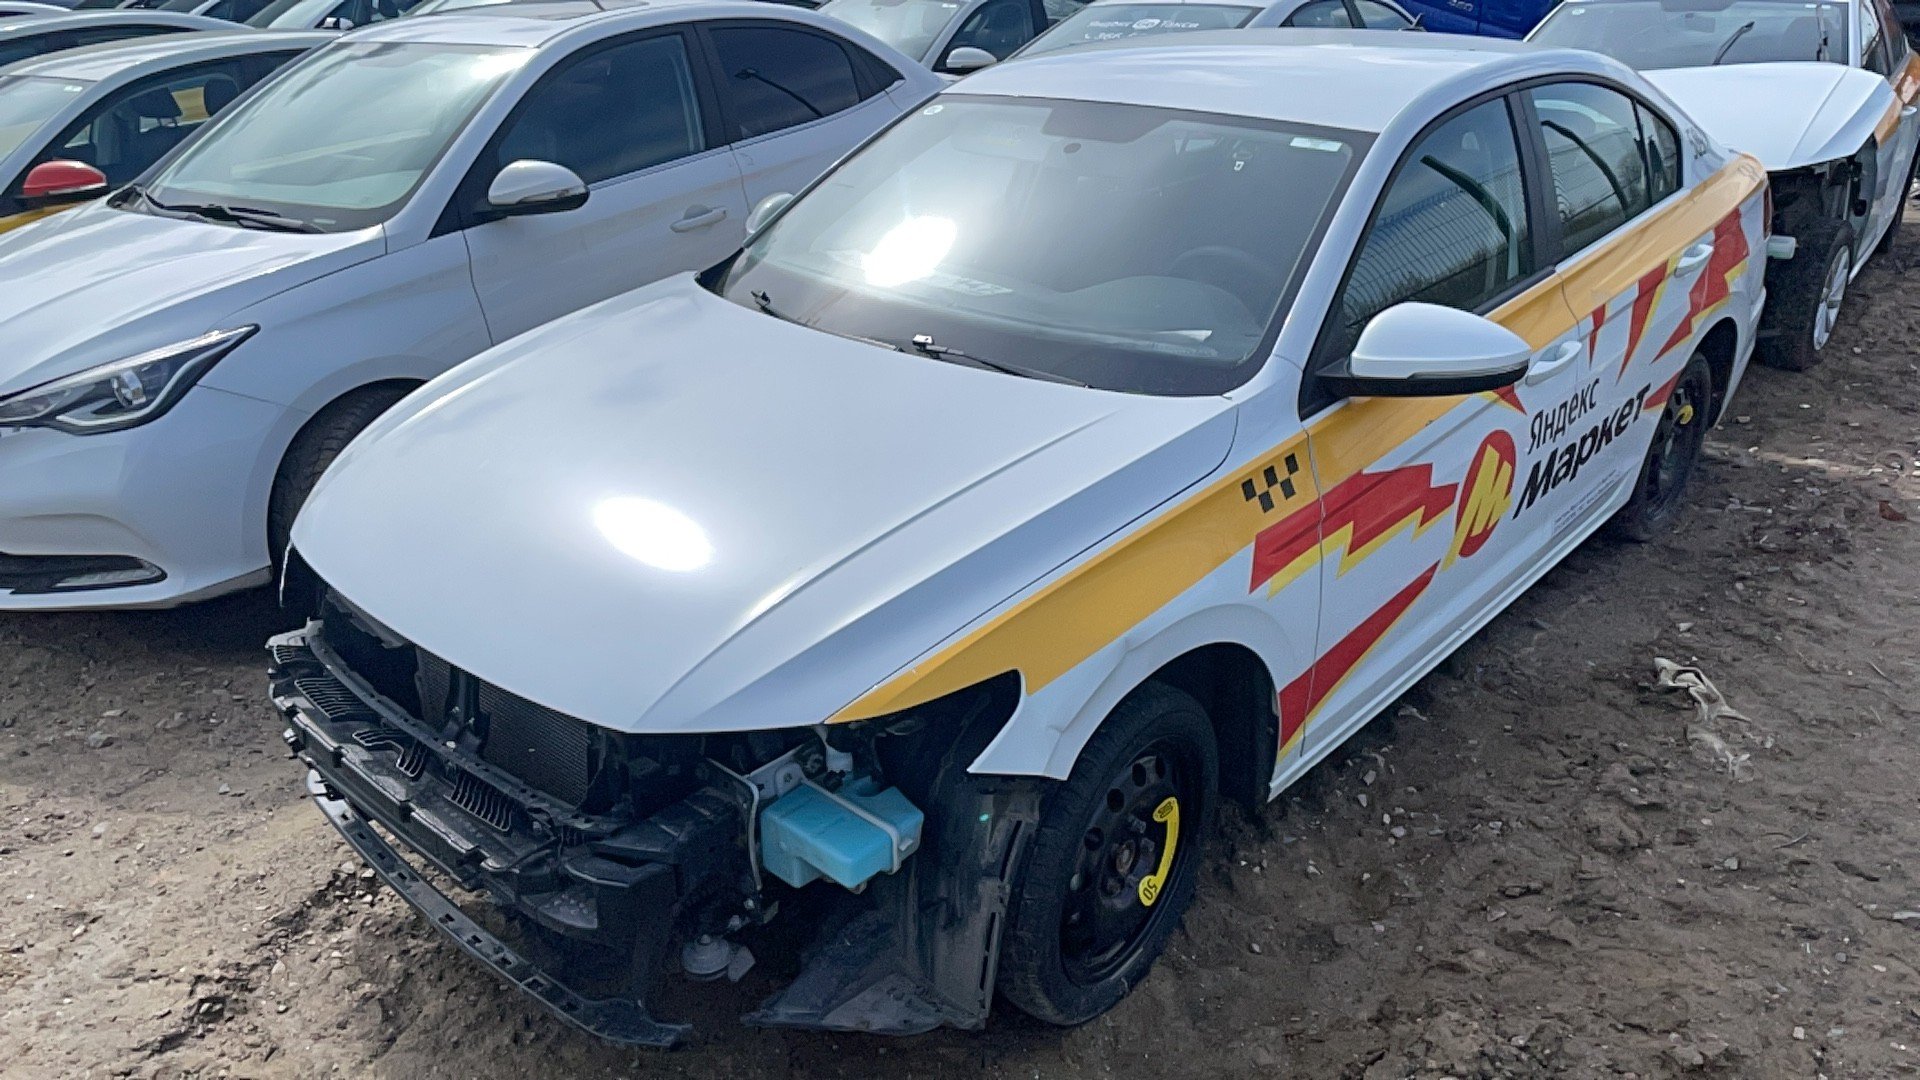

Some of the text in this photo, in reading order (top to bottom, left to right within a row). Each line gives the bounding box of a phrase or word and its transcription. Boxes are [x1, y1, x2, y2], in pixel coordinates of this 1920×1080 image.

[1512, 383, 1651, 520] Маркет
[1527, 378, 1600, 455] Яндекс
[1143, 878, 1158, 901] 50
